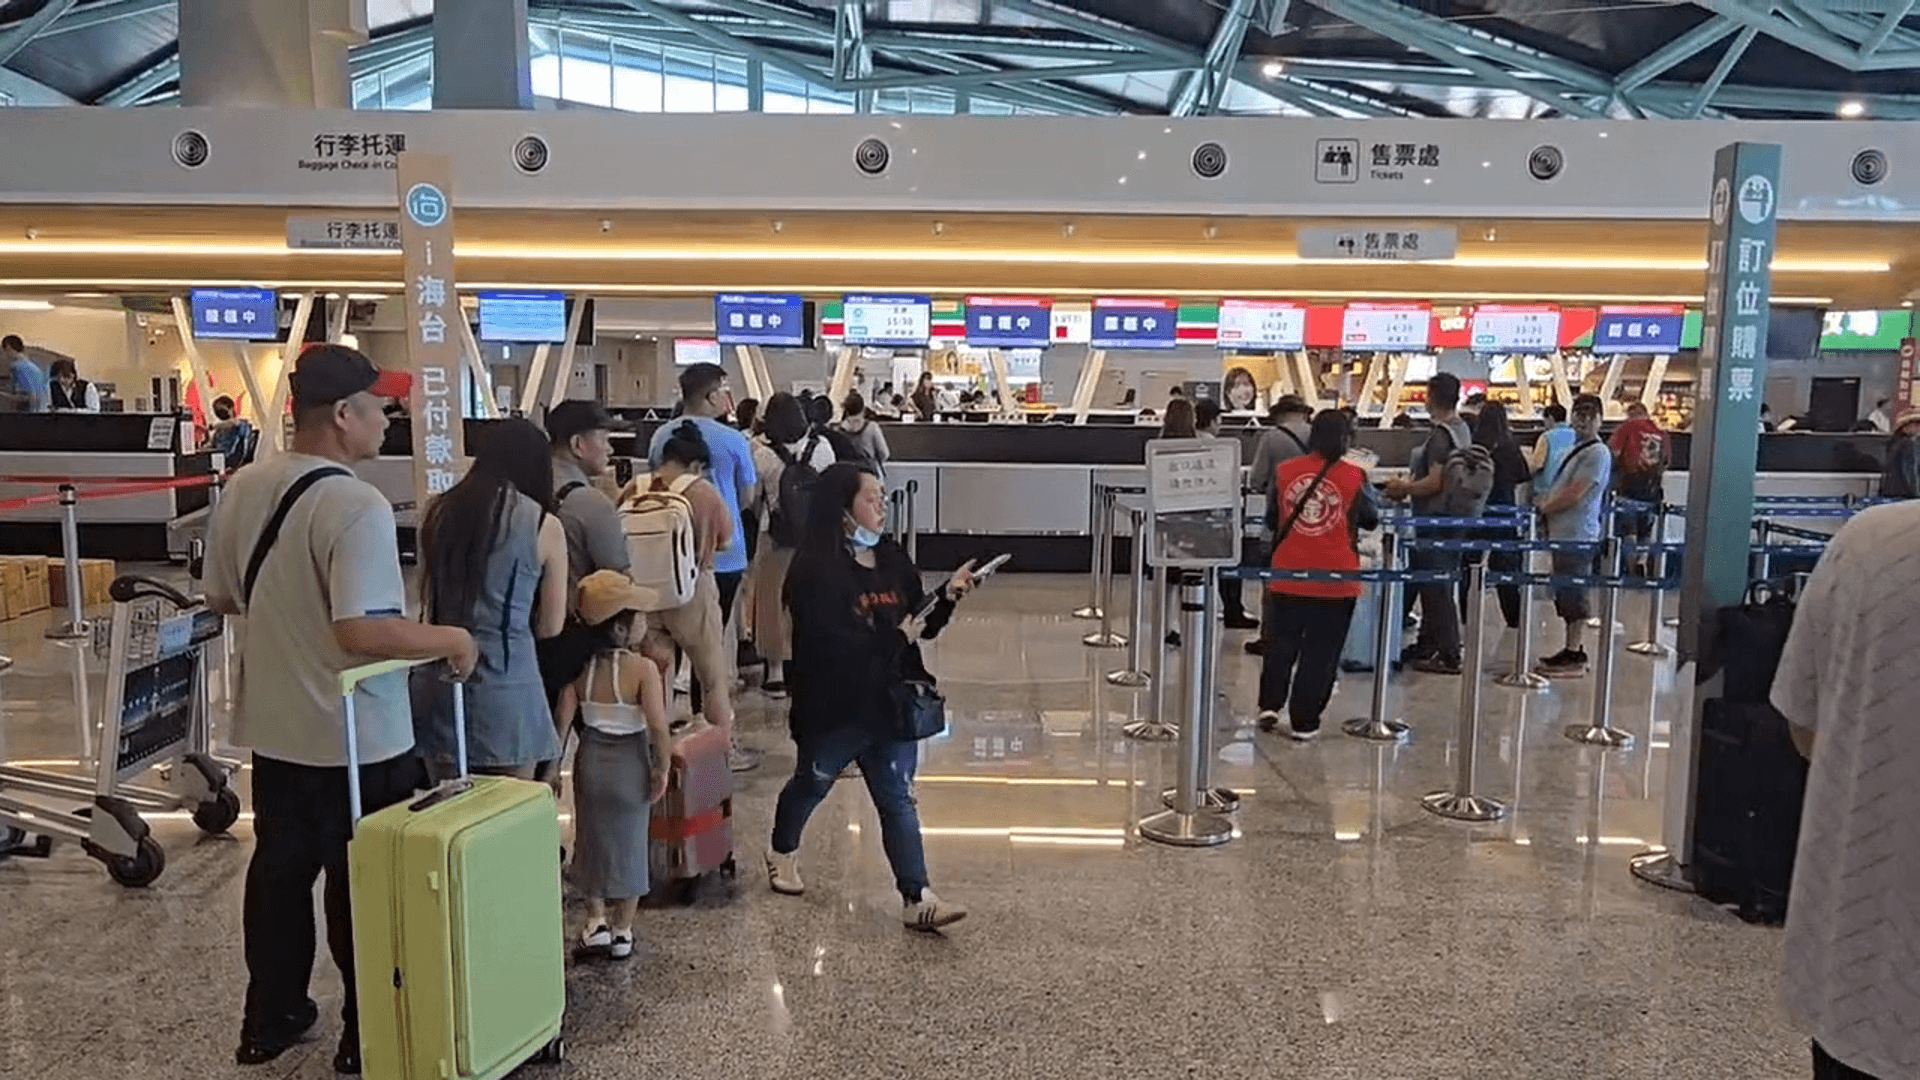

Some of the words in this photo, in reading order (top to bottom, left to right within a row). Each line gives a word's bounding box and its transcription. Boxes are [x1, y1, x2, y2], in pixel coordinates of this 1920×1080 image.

[314, 133, 405, 157] 行李托運
[1371, 143, 1440, 167] 售票處
[298, 160, 338, 171] Baggage
[1371, 170, 1404, 180] Tickets
[327, 222, 399, 239] 行李托運
[1364, 232, 1419, 250] 售票處
[1728, 237, 1767, 402] 訂位購票
